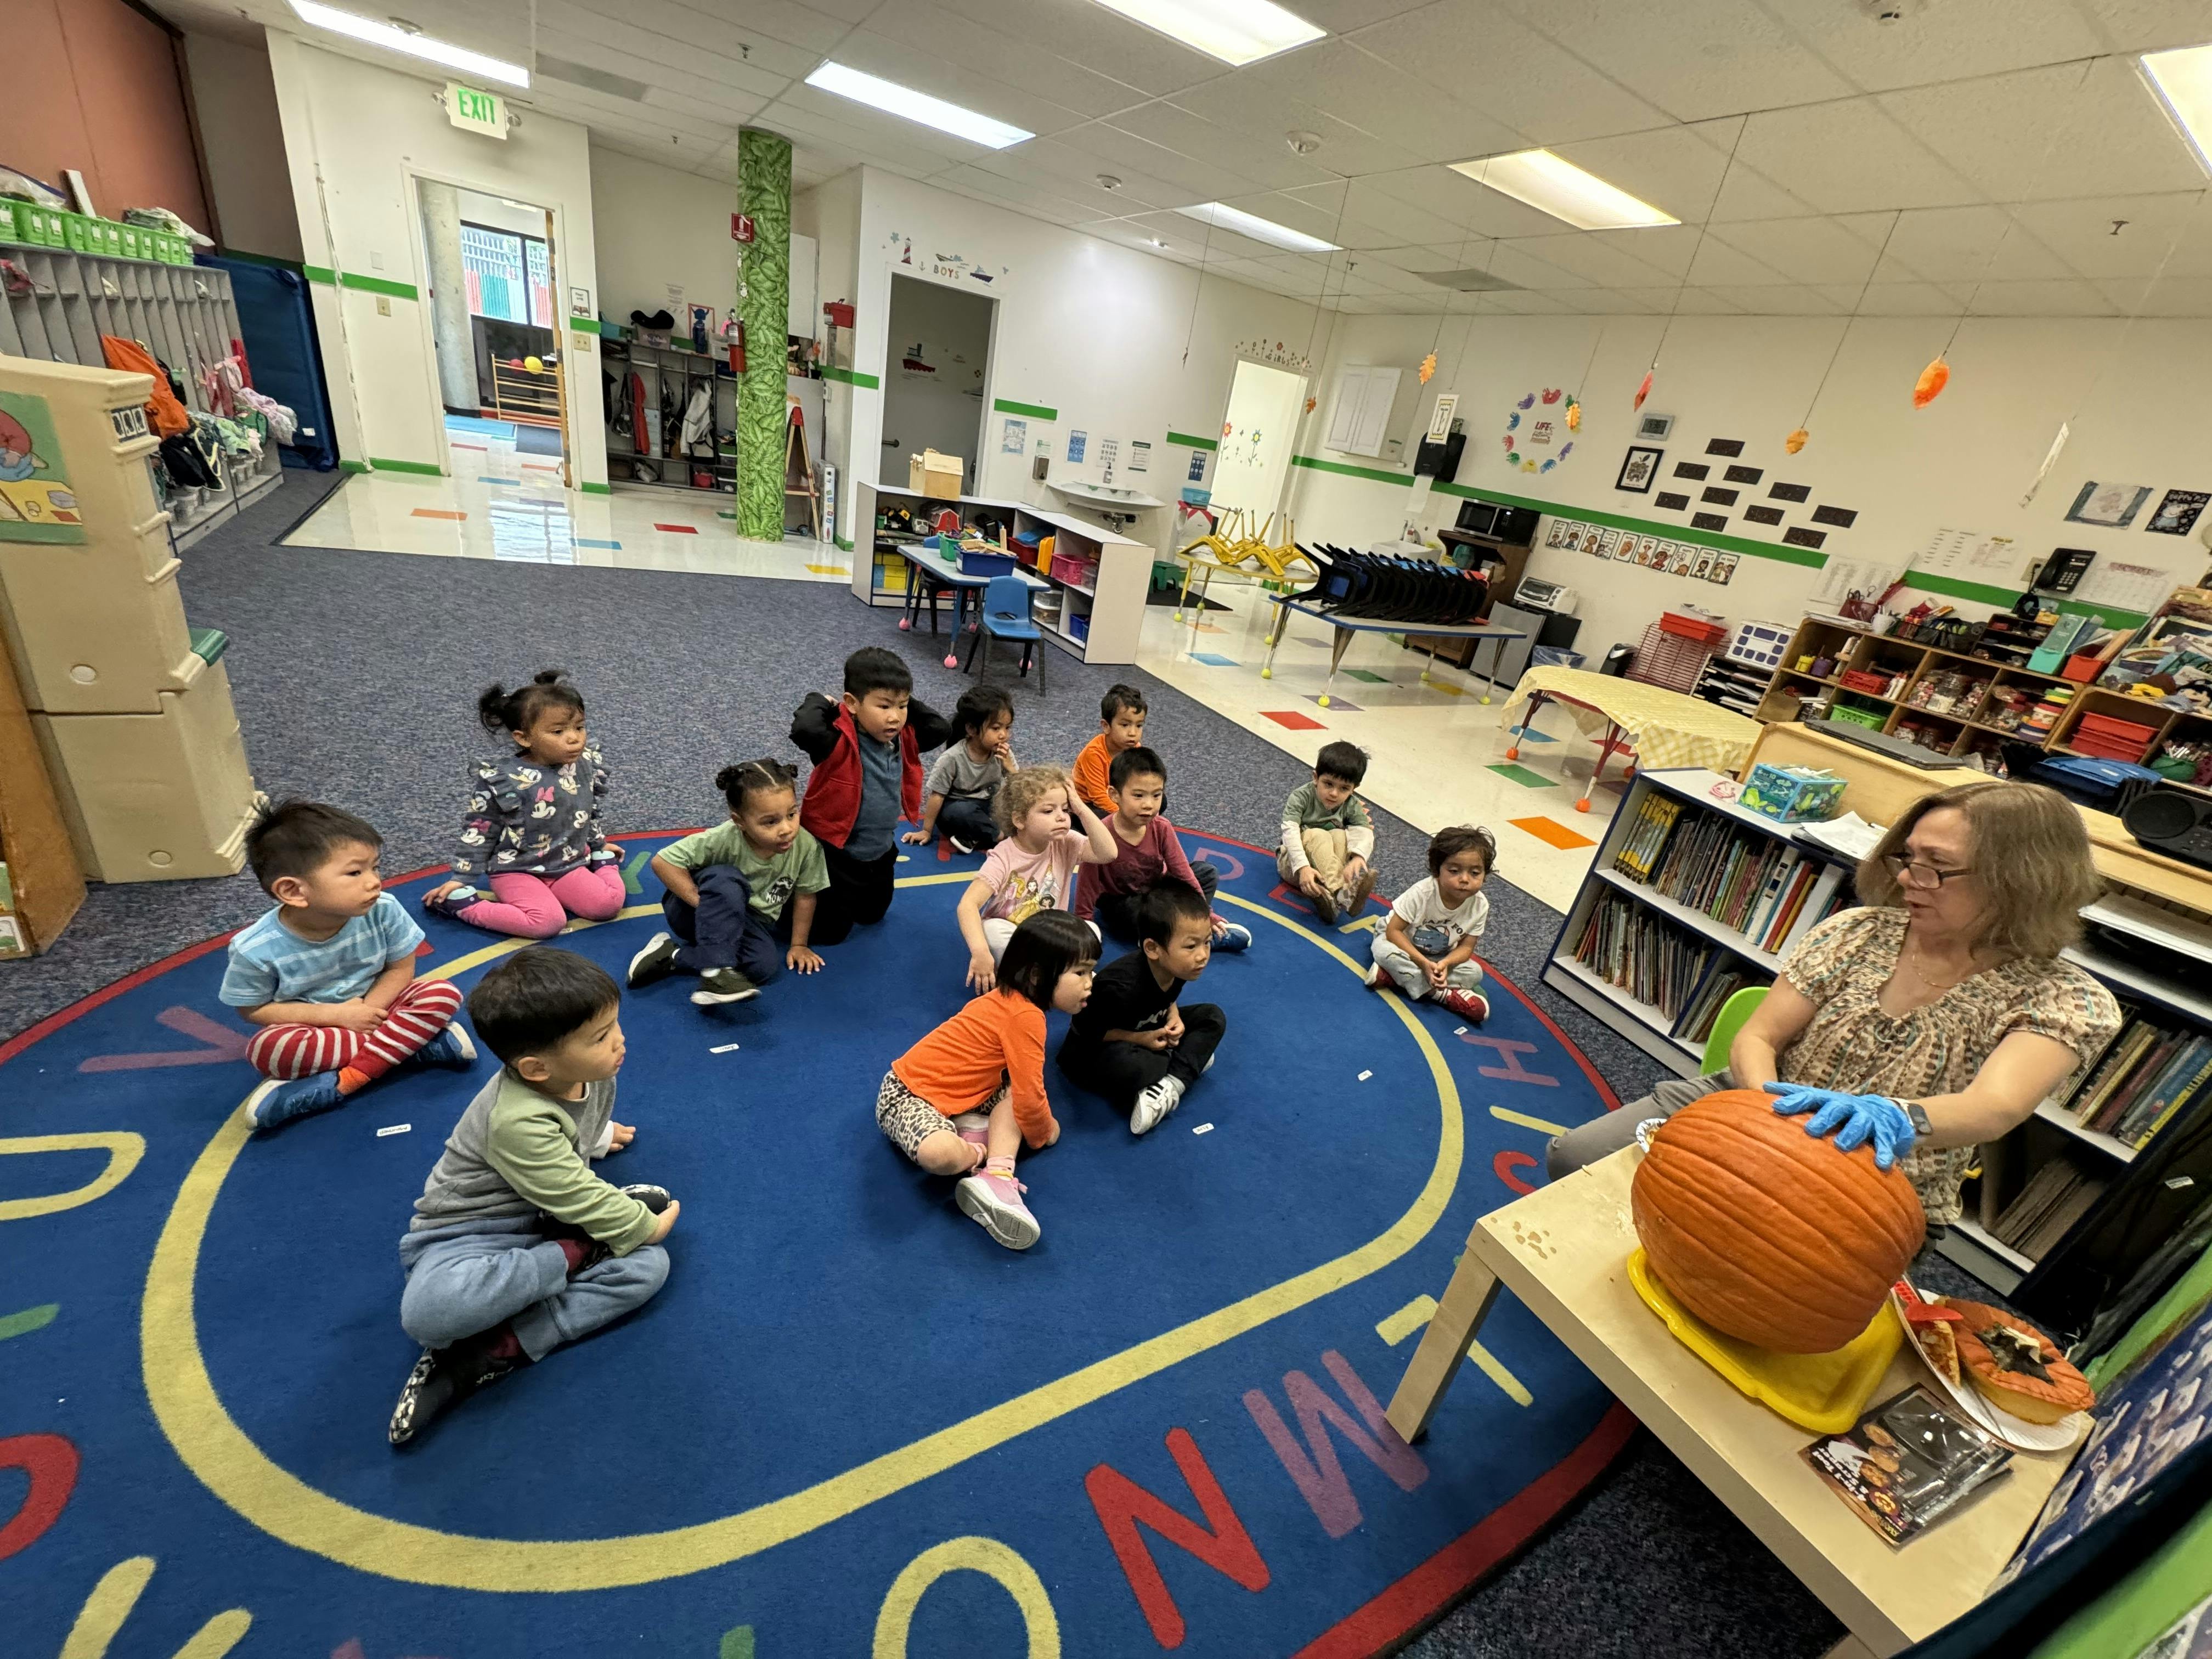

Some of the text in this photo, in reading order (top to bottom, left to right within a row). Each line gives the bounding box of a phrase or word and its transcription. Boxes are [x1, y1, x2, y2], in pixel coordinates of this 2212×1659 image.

[458, 87, 495, 125] EXIT
[934, 264, 959, 279] BOYS
[1812, 1451, 1835, 1473] Tool
[1818, 1447, 1859, 1486] Scraper
[1084, 1426, 1271, 1650] N
